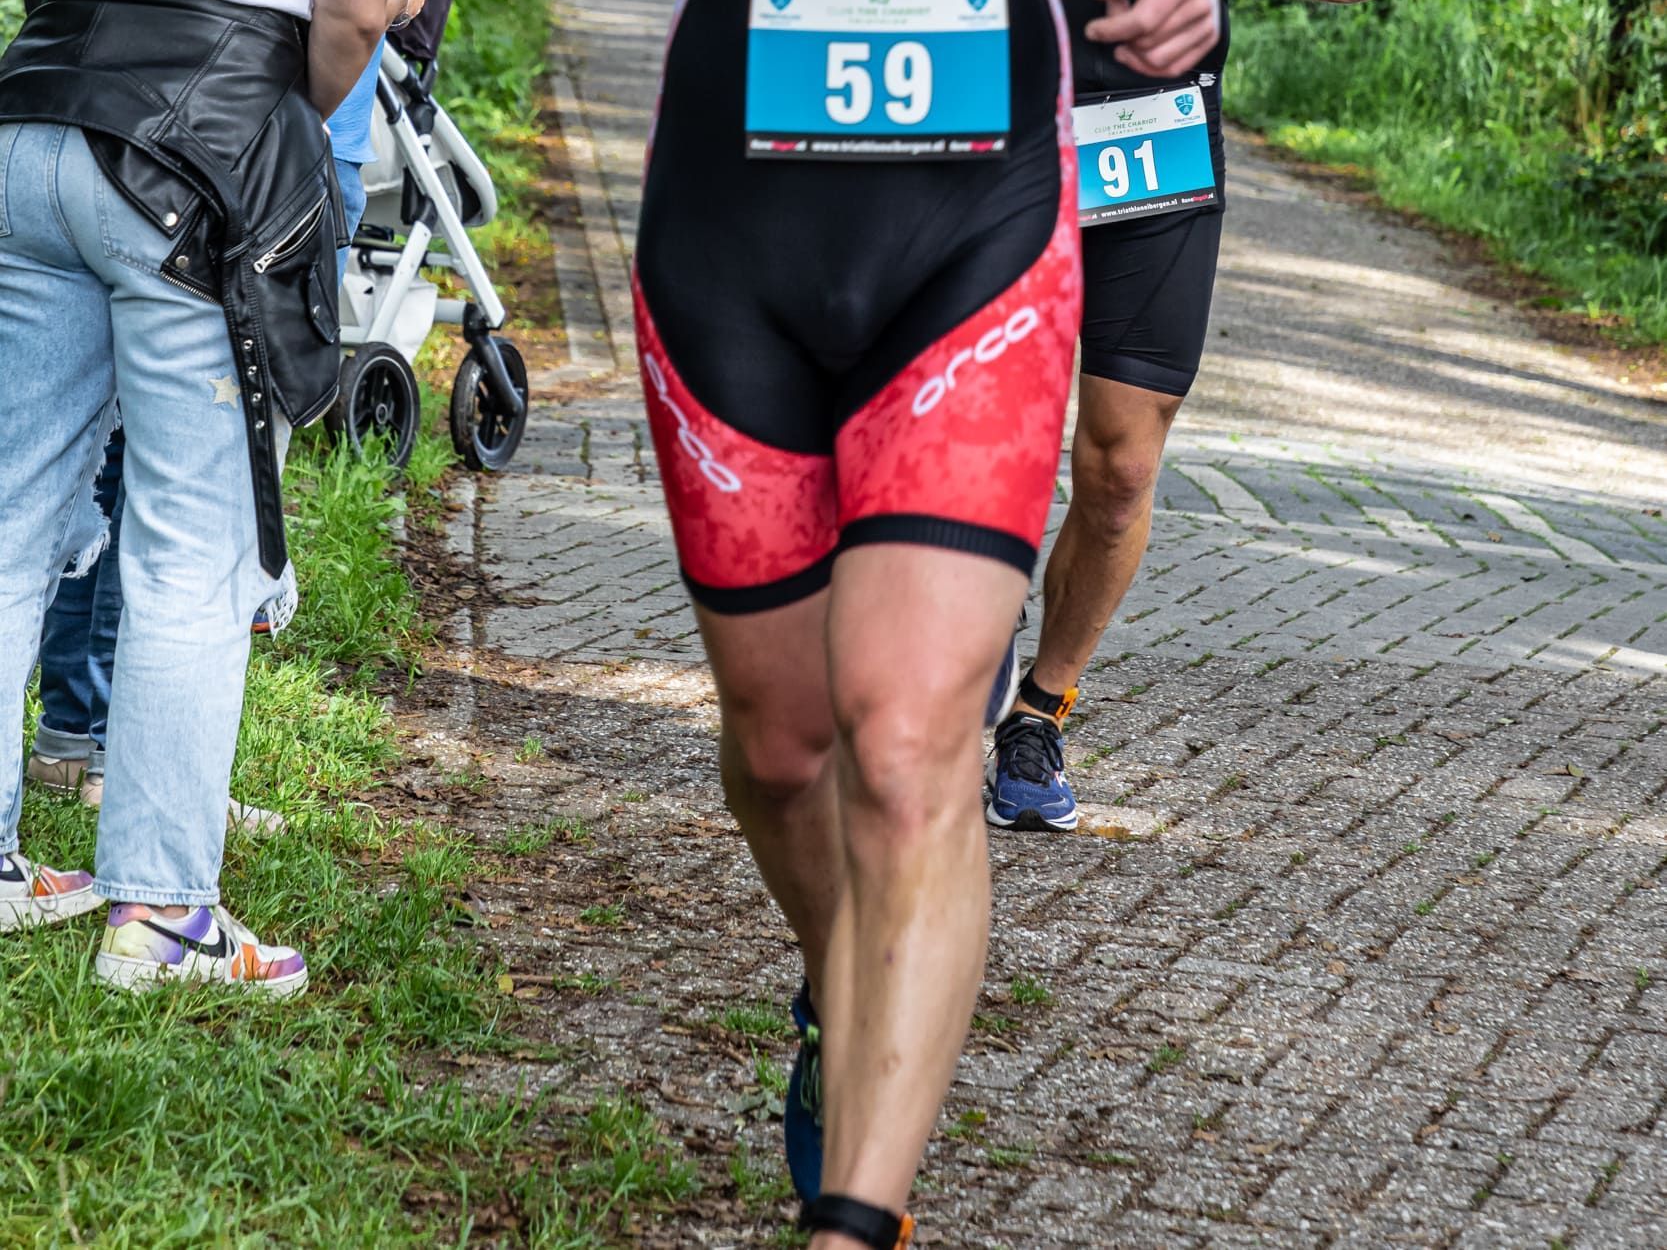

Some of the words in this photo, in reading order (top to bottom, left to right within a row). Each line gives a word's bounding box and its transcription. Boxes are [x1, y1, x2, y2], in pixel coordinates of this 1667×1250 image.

[825, 40, 933, 125] 59
[1113, 122, 1126, 130] THE
[1127, 117, 1158, 129] CHARIOT
[1097, 139, 1159, 199] 91
